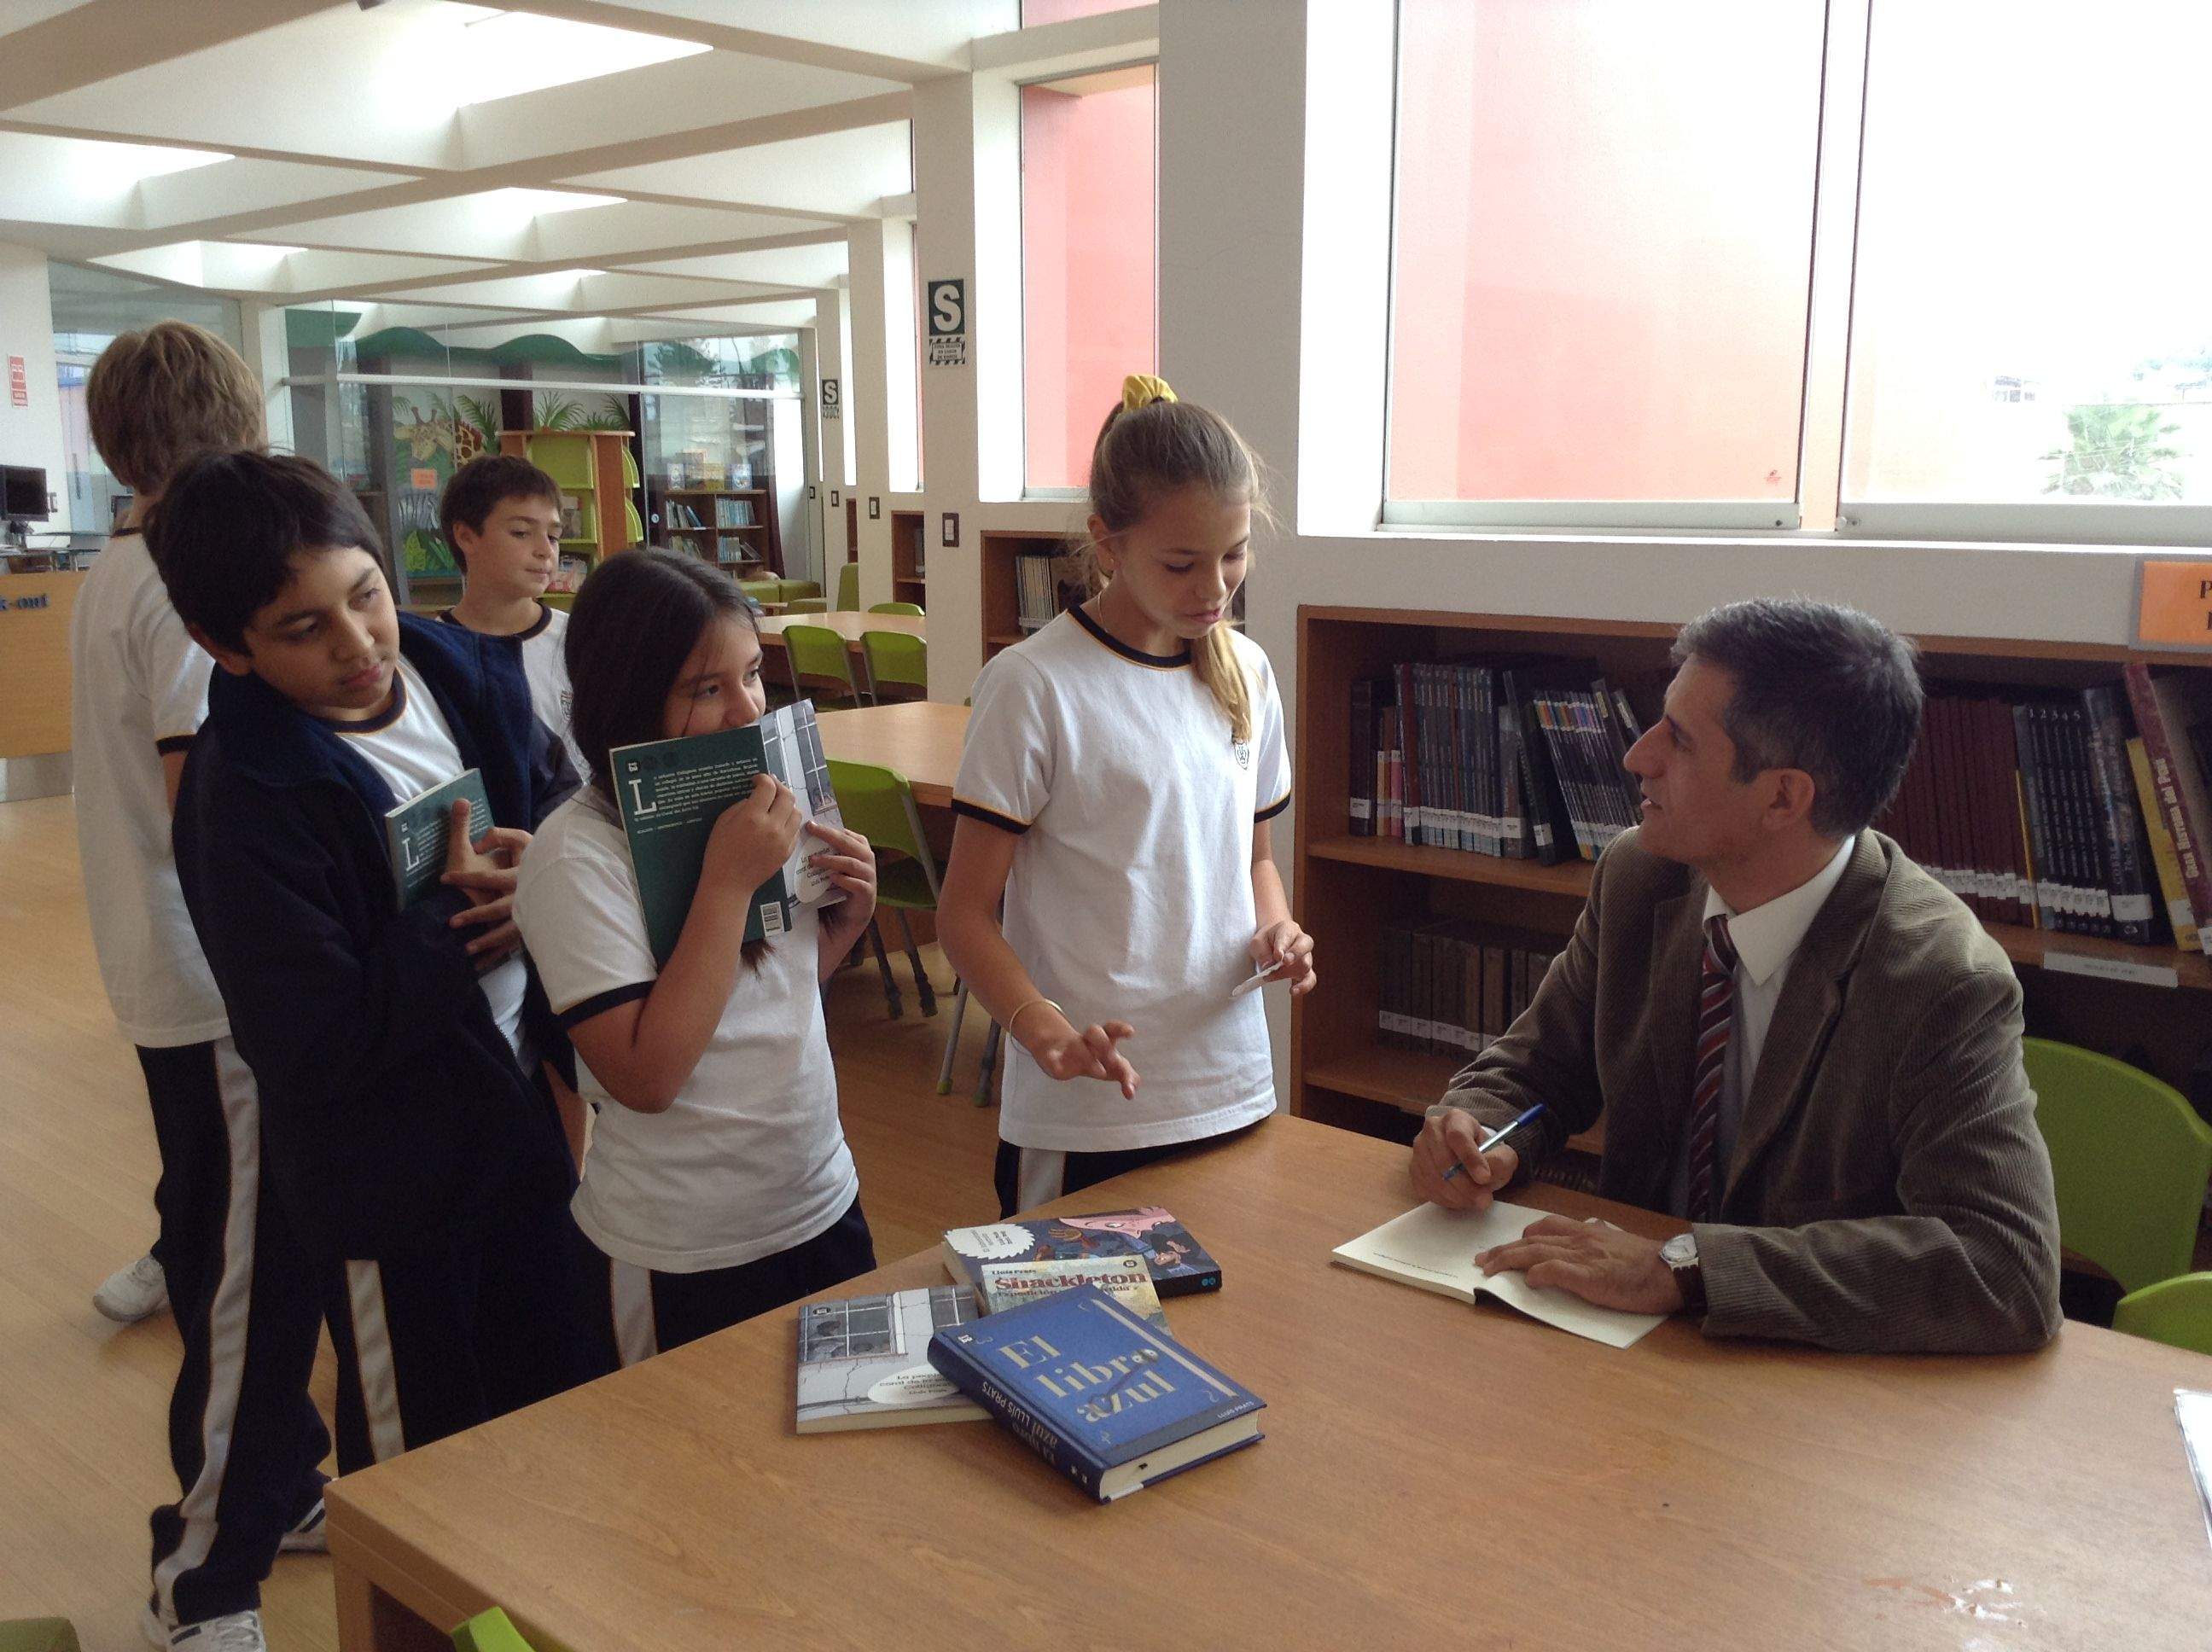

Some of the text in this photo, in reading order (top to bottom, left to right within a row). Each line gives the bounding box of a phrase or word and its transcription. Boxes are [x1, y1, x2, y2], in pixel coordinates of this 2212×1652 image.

[934, 284, 962, 331] S
[824, 381, 838, 404] S
[994, 1274, 1148, 1290] Shackleton
[998, 1335, 1061, 1370] El
[982, 1381, 1007, 1407] PRATS
[1076, 1370, 1178, 1422] azul
